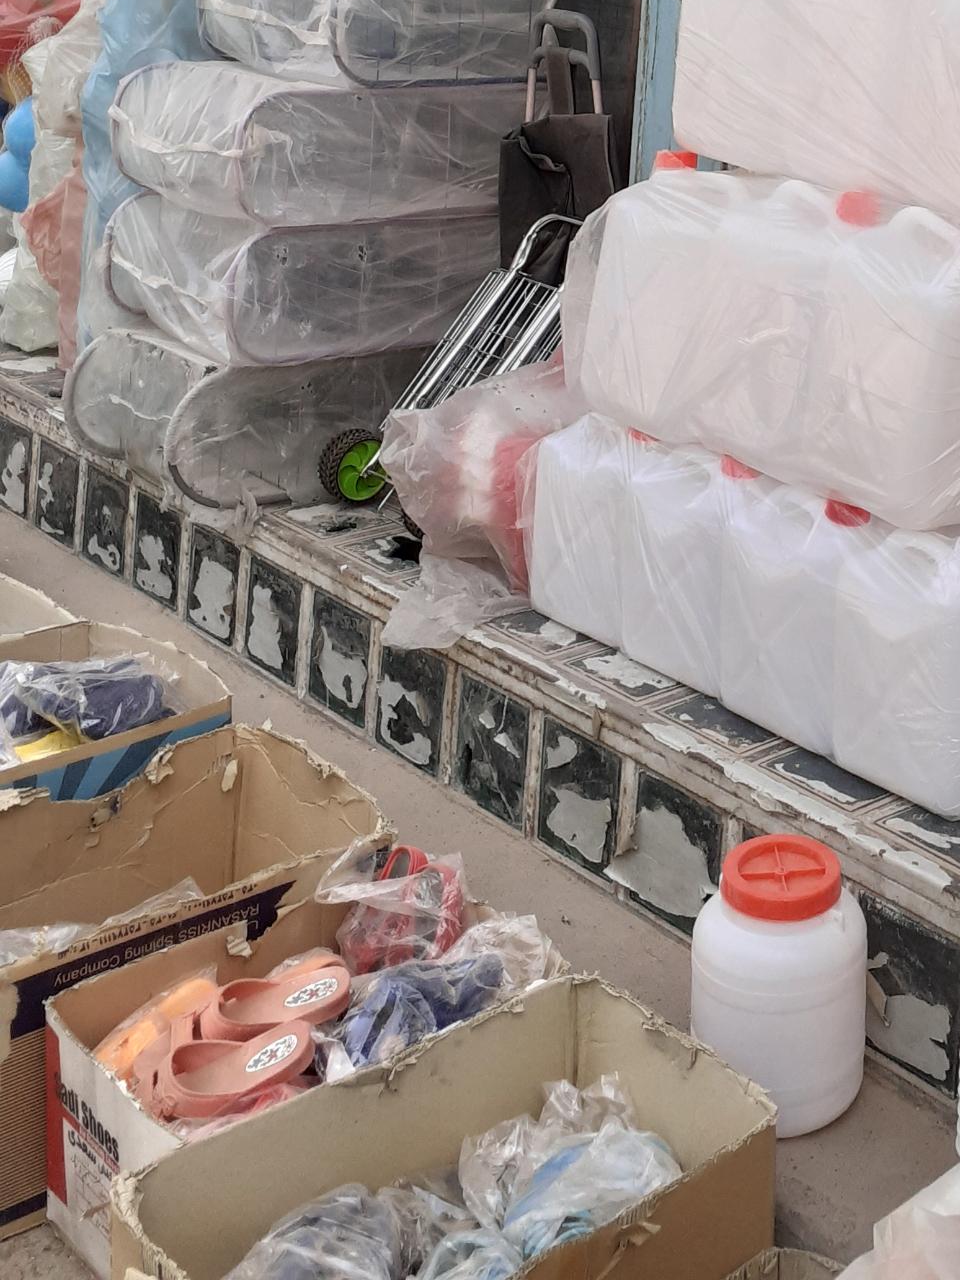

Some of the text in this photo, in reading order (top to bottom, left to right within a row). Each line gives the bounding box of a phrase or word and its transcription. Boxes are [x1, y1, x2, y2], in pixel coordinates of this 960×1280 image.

[178, 903, 260, 945] RASANRISS
[124, 934, 174, 957] Spining
[53, 954, 120, 988] Company
[81, 1100, 120, 1163] Shoes
